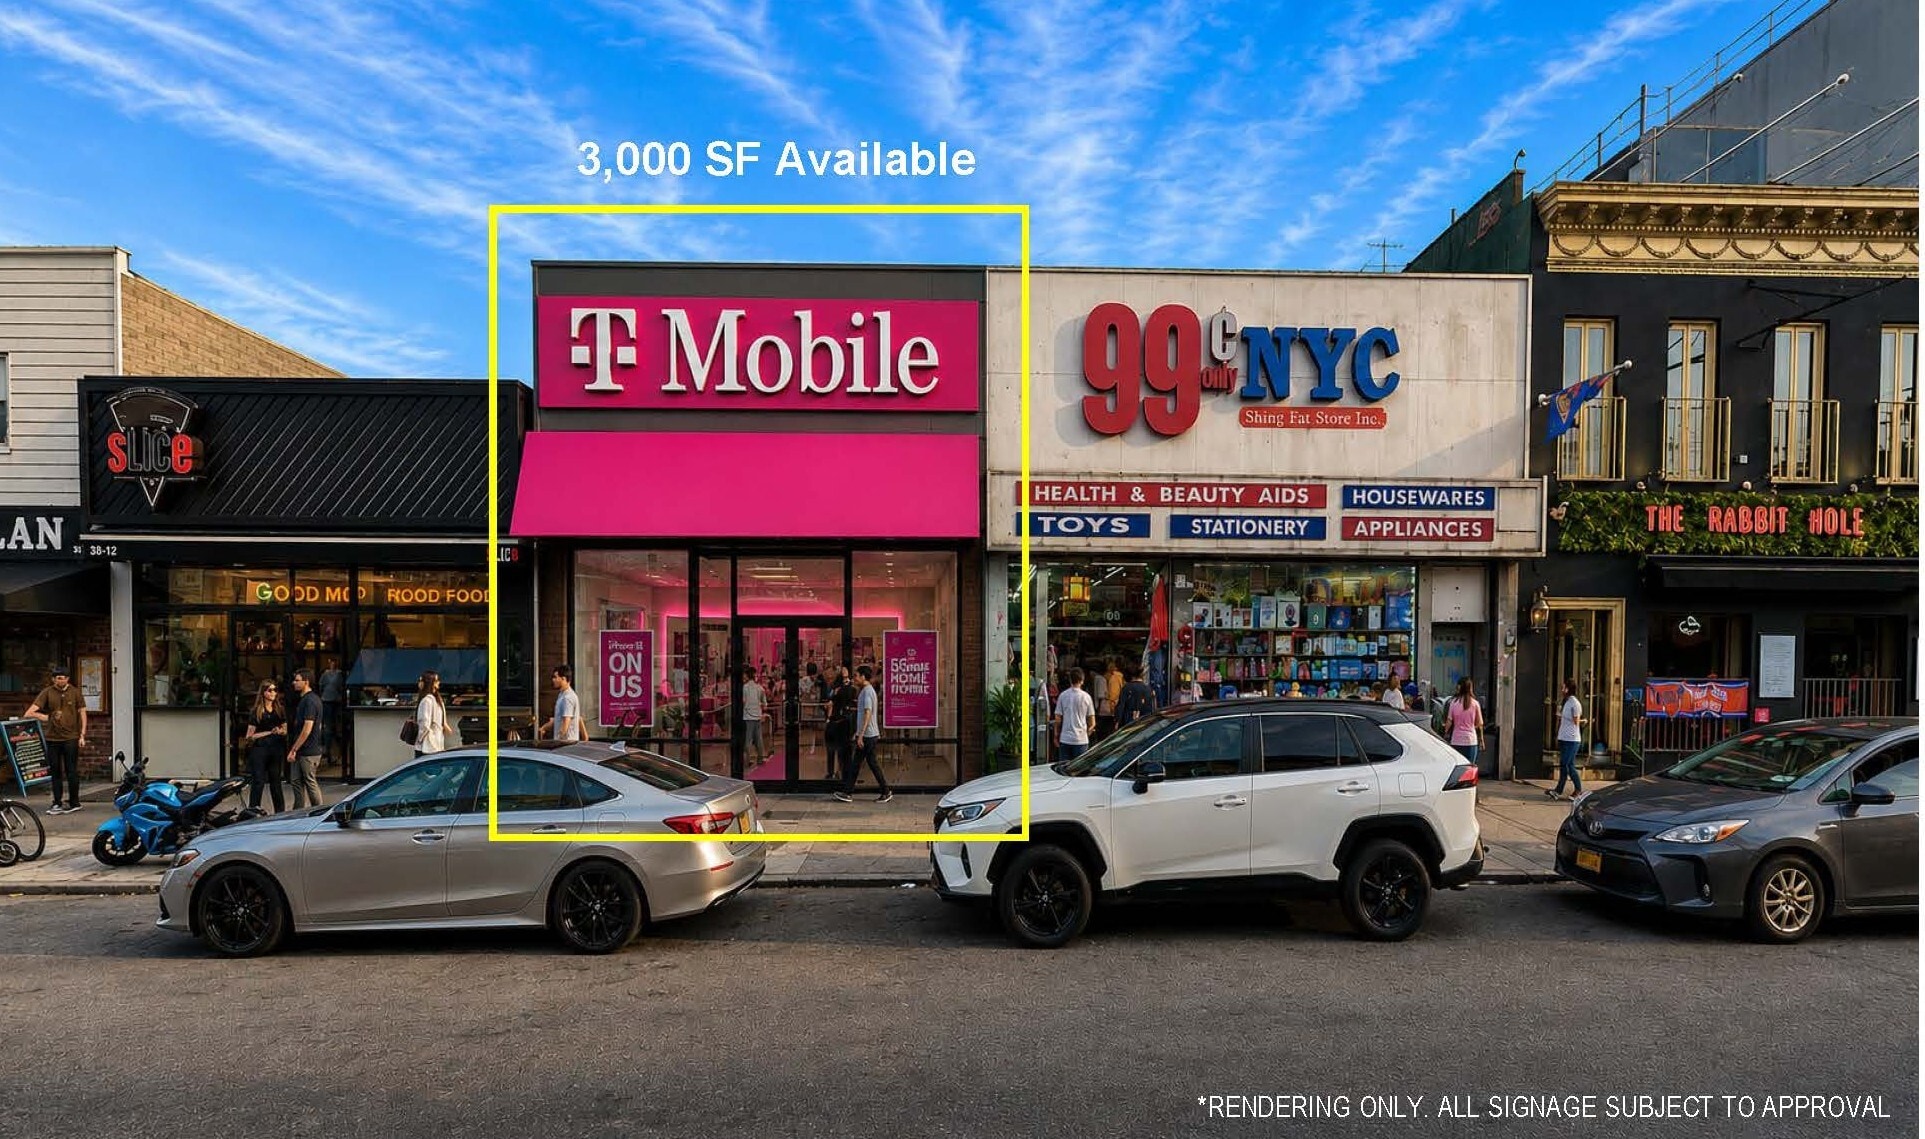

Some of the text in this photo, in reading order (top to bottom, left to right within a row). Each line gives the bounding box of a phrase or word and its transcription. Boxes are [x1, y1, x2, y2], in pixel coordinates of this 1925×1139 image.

[661, 308, 939, 394] Mobile
[1083, 302, 1202, 435] 99
[1241, 326, 1400, 401] NYC
[1201, 361, 1238, 395] only
[1245, 410, 1284, 428] Shing
[1316, 411, 1351, 425] Store
[1034, 485, 1310, 504] HEALTH & BEAUTY AIDS
[1352, 489, 1486, 506] HOUSEWARES
[1037, 516, 1130, 534] TOYS
[1191, 518, 1310, 536] STATIONERY
[1353, 520, 1483, 537] APPLIANCES
[1645, 504, 1865, 536] THE RABBIT HOLE
[0, 516, 64, 550] AN
[608, 651, 643, 674] ON
[609, 674, 643, 698] US
